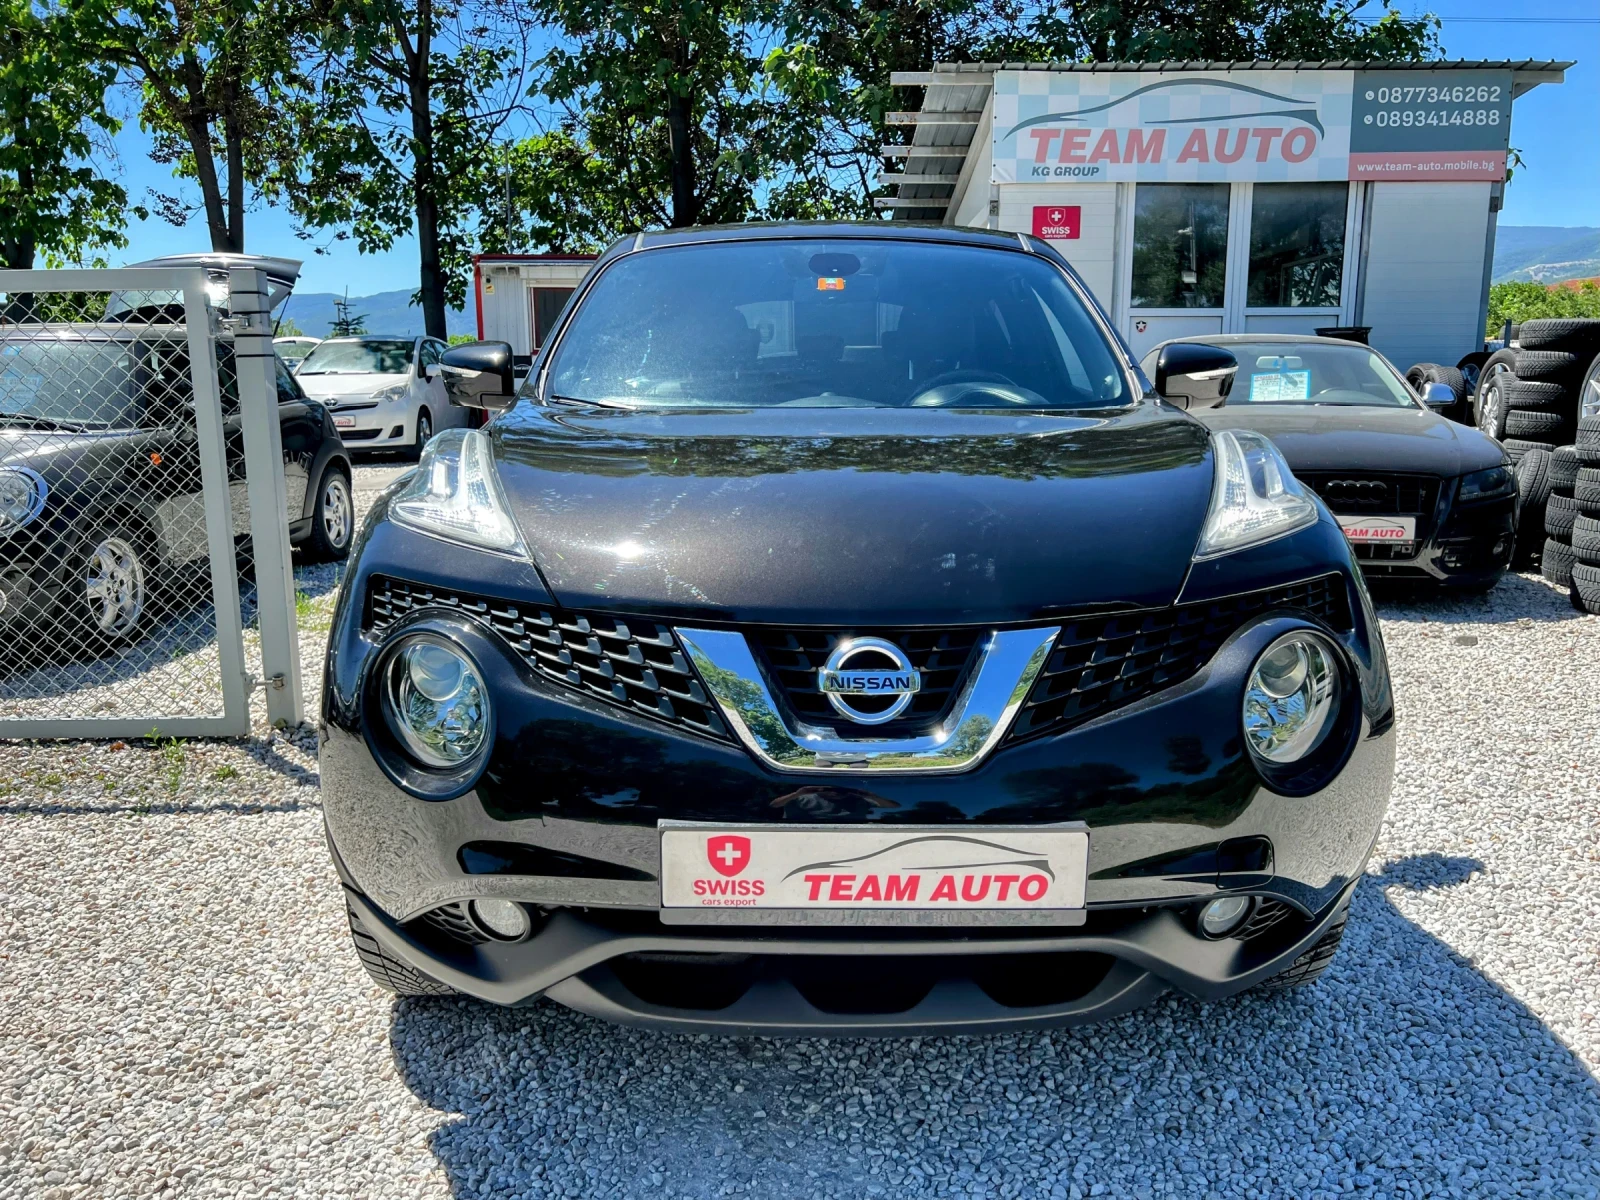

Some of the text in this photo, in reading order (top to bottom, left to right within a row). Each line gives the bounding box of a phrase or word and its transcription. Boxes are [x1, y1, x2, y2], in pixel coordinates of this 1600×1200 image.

[1377, 86, 1501, 104] 0877346262
[1376, 109, 1500, 127] 0893414888
[1029, 126, 1317, 164] TEAM AUTO
[1031, 166, 1100, 177] KG GROUP
[1357, 160, 1495, 172] www.team-auto.mobile.bg
[1041, 226, 1071, 235] SWISS
[1343, 528, 1404, 538] EAM AUTO
[830, 676, 910, 690] NISSAN
[693, 879, 766, 897] SWISS
[803, 873, 1049, 902] TEAM AUTO
[724, 898, 757, 908] export
